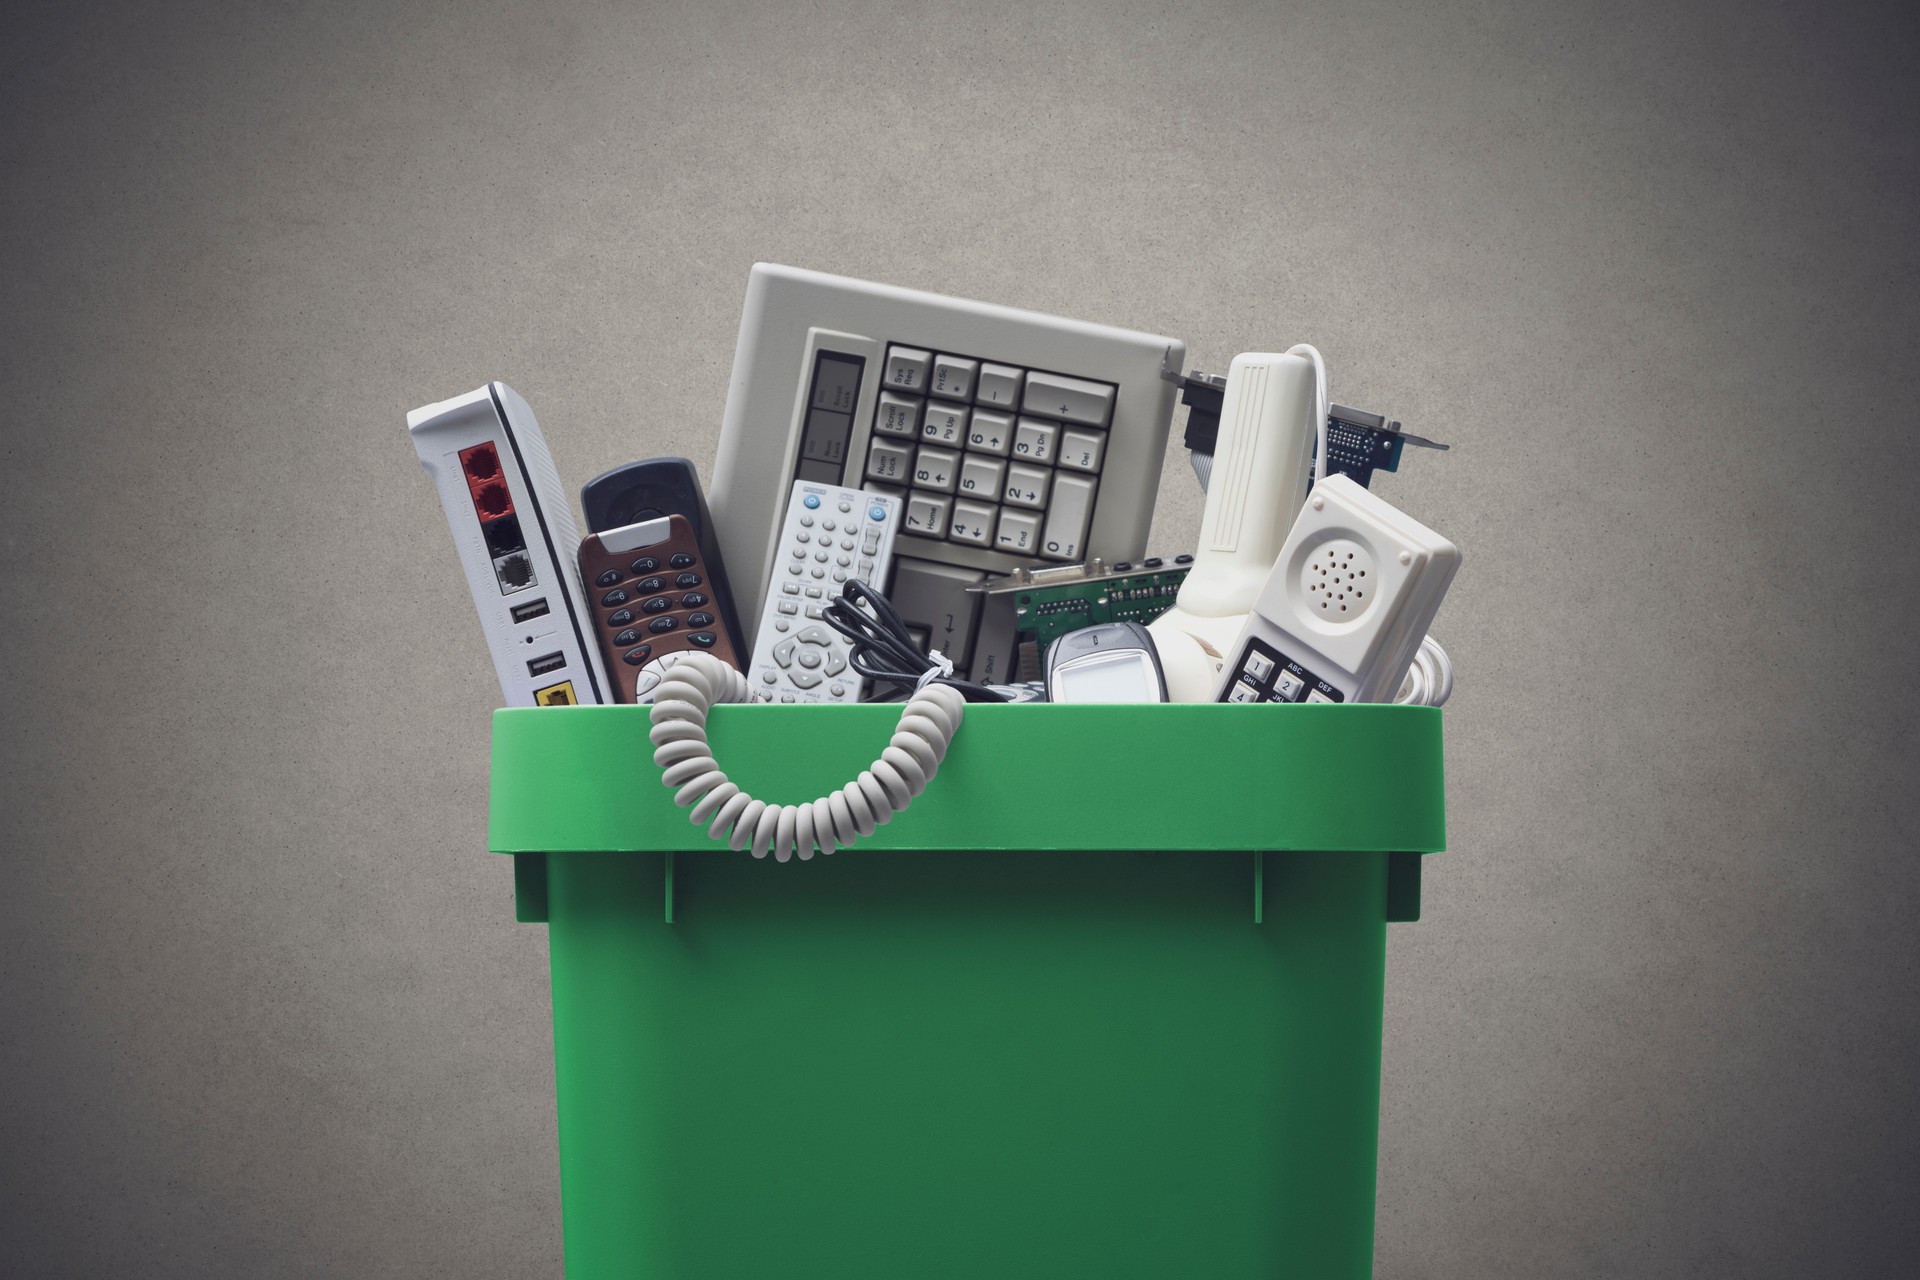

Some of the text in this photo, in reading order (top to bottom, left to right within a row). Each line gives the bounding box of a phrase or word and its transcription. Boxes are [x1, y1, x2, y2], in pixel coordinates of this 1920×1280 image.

[894, 368, 904, 384] Sys
[904, 369, 915, 385] Req
[937, 368, 948, 391] PrtSc
[885, 406, 897, 429] Scroll
[895, 411, 905, 431] Lock
[925, 425, 937, 435] 9
[944, 416, 955, 440] Pg Up
[971, 433, 983, 444] 6
[1017, 442, 1029, 453] 3
[1035, 433, 1046, 457] Pg Dn
[877, 455, 887, 475] Num
[1081, 452, 1090, 466] Del
[887, 456, 897, 476] Lock
[917, 470, 929, 481] 8
[963, 479, 975, 490] 5
[1008, 488, 1021, 499] 2
[908, 516, 921, 526] 7
[926, 507, 937, 530] Home
[954, 523, 967, 534] 4
[1000, 535, 1012, 543] 1
[1018, 531, 1027, 547] End
[1047, 541, 1059, 552] 0
[1066, 544, 1074, 557] Ins
[985, 655, 996, 674] Shift
[1254, 662, 1259, 671] 1
[1287, 662, 1303, 675] ABC
[837, 678, 855, 686] RETURN
[1243, 674, 1257, 686] GHI
[1282, 681, 1291, 691] 2
[780, 687, 801, 695] SUBTITLE
[1318, 681, 1333, 693] DEF
[1236, 693, 1244, 702] 4
